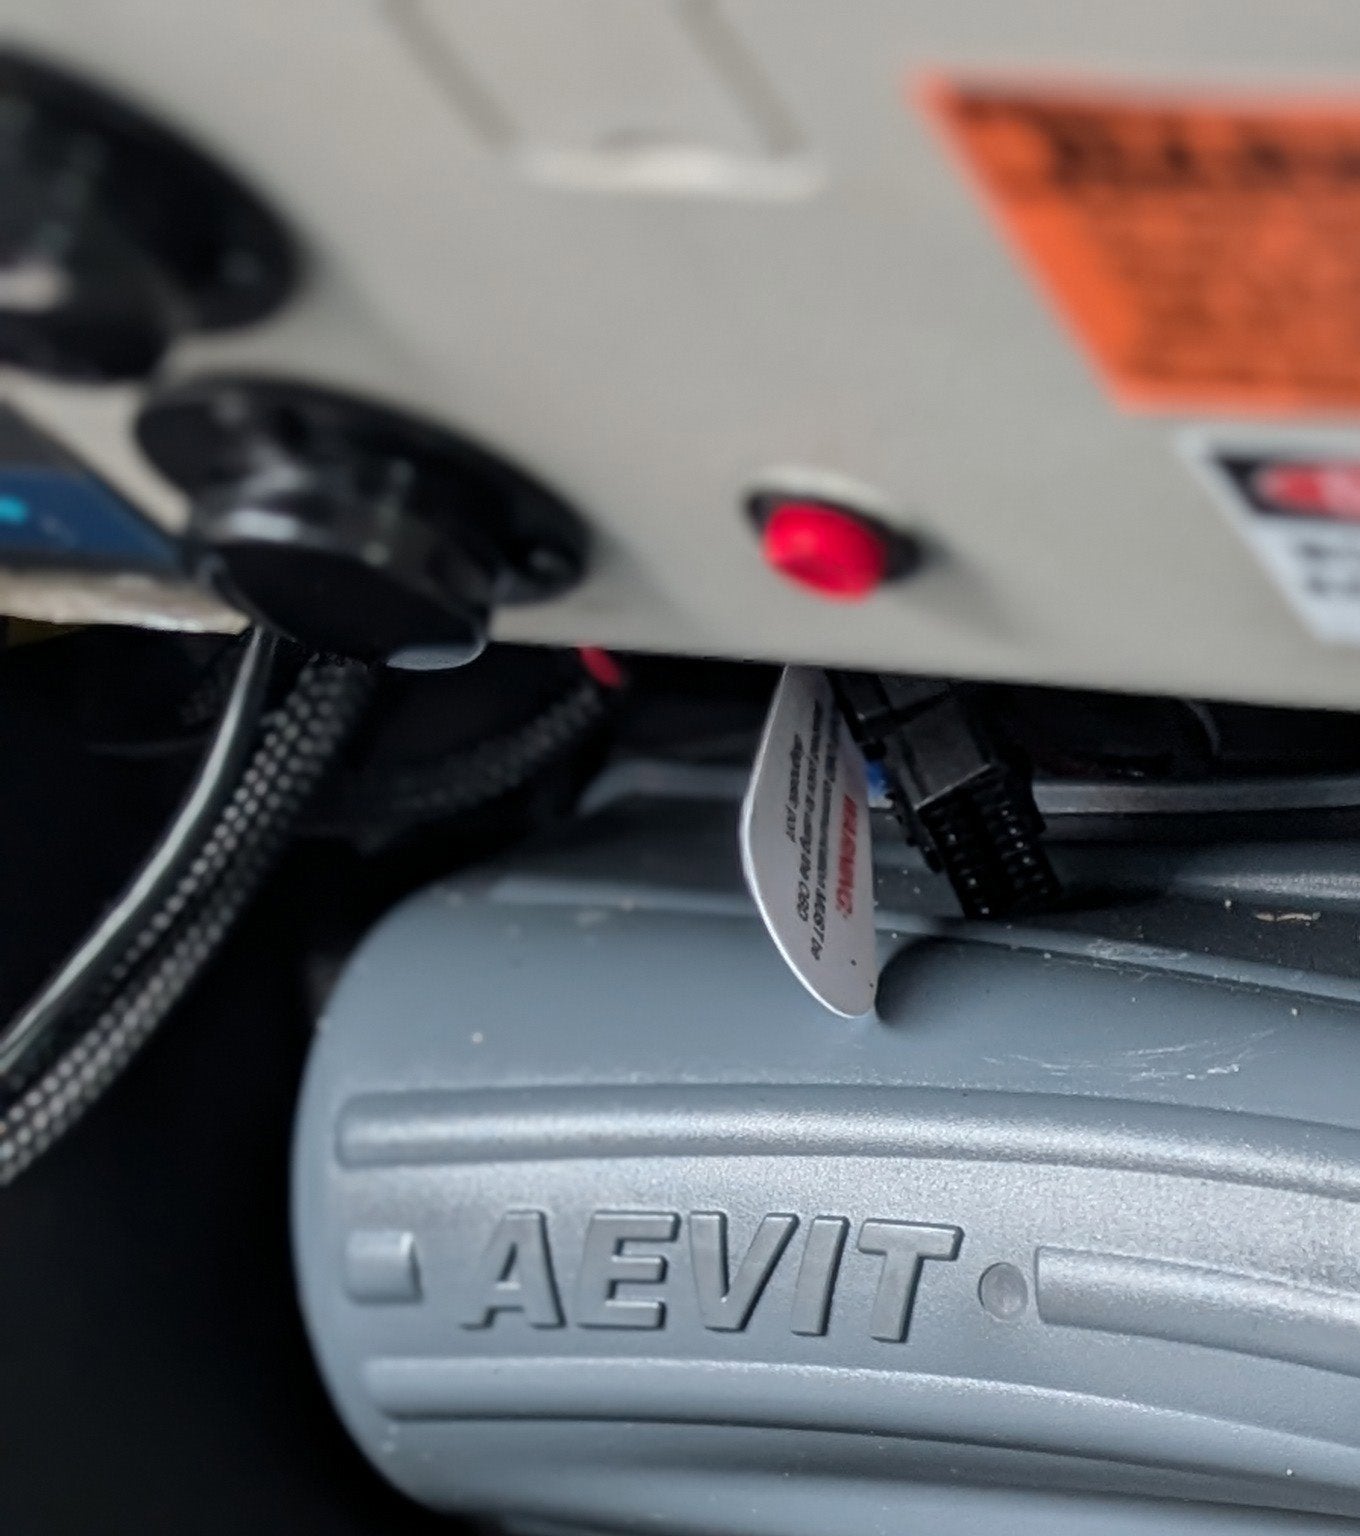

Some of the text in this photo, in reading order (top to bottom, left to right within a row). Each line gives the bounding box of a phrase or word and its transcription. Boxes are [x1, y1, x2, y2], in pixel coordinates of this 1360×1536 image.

[785, 805, 797, 844] port
[798, 854, 810, 881] the
[796, 881, 809, 922] OBD
[812, 887, 827, 944] MUST
[808, 936, 823, 962] be
[459, 1209, 965, 1344] AEVIT
